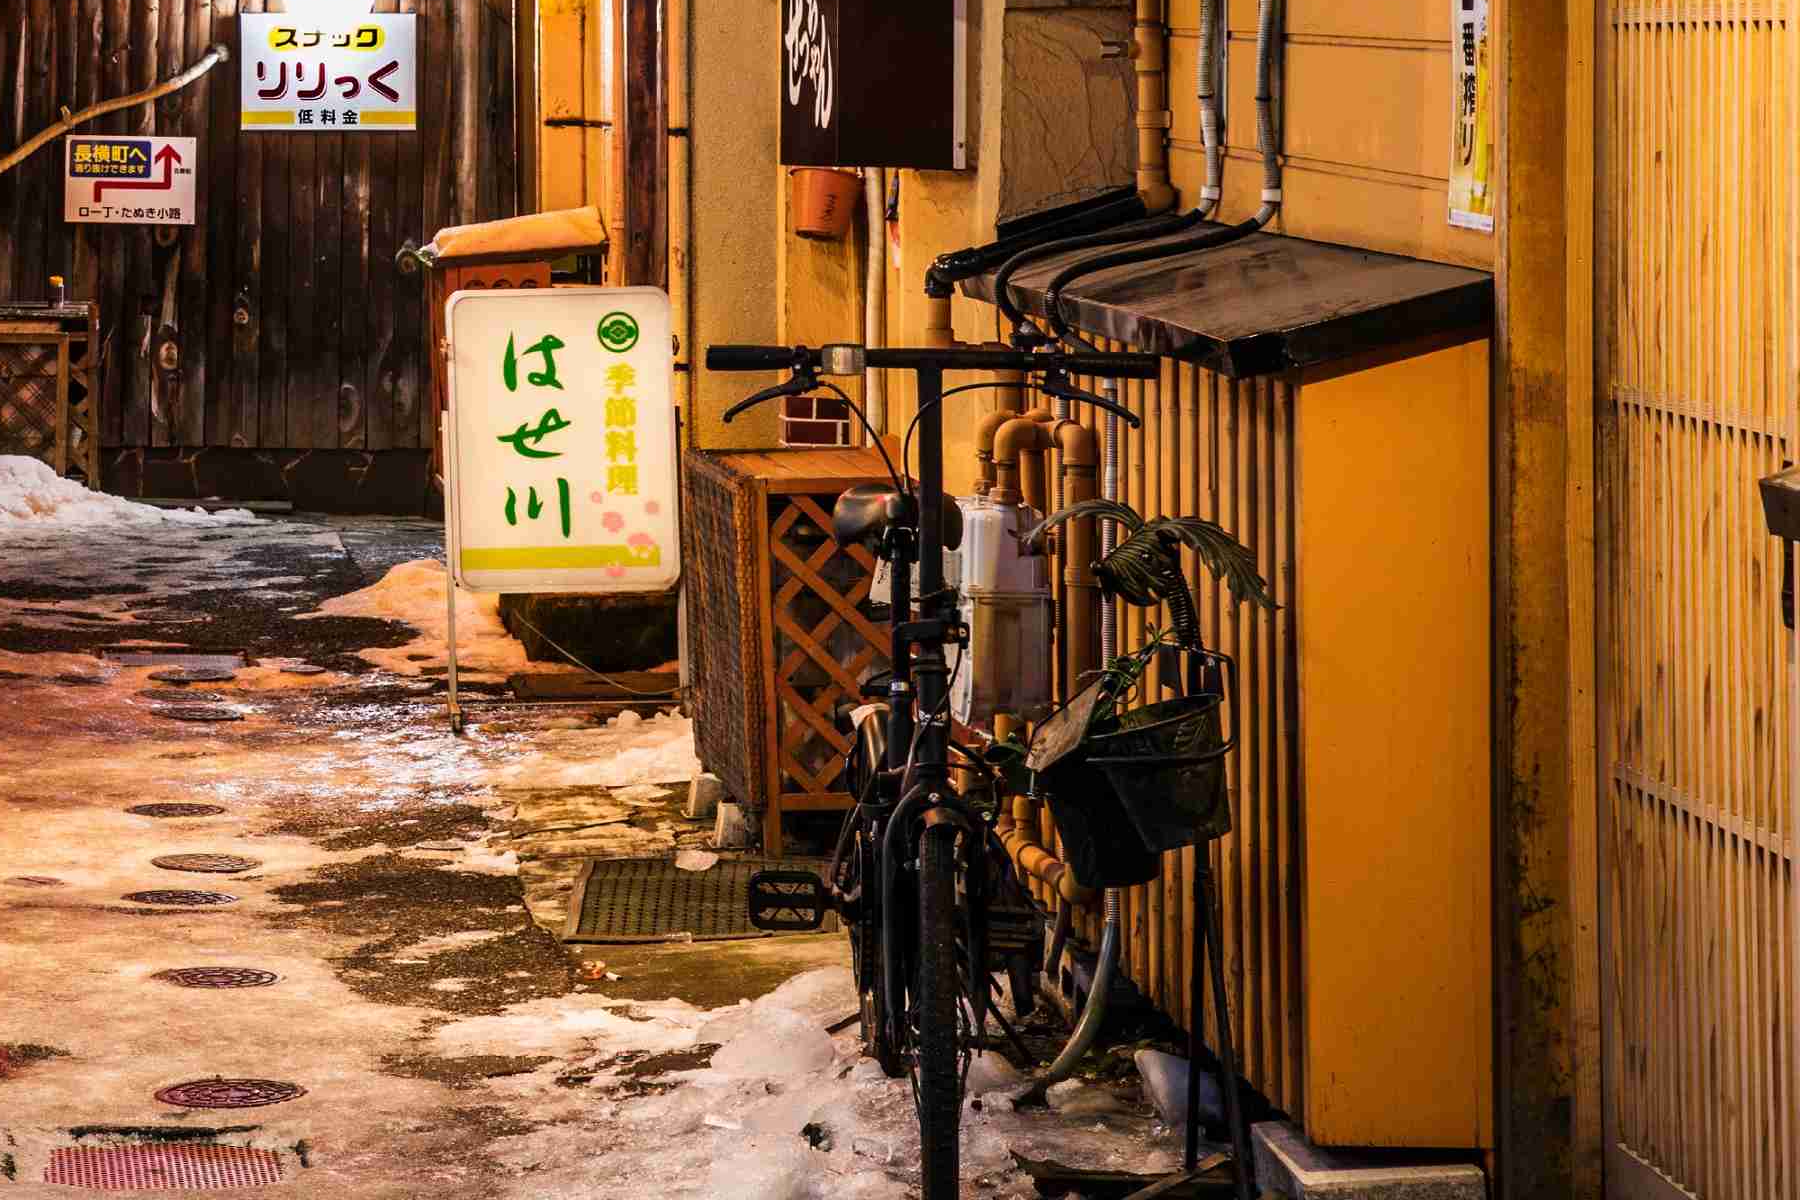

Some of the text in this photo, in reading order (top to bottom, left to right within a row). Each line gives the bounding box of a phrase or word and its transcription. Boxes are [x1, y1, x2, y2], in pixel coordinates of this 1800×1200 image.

[274, 27, 379, 48] スナック
[256, 59, 400, 103] りりっく
[297, 108, 359, 126] 低料金
[74, 144, 148, 163] 長横町へ
[495, 329, 572, 539] はせ川
[602, 361, 640, 496] 季節料理
